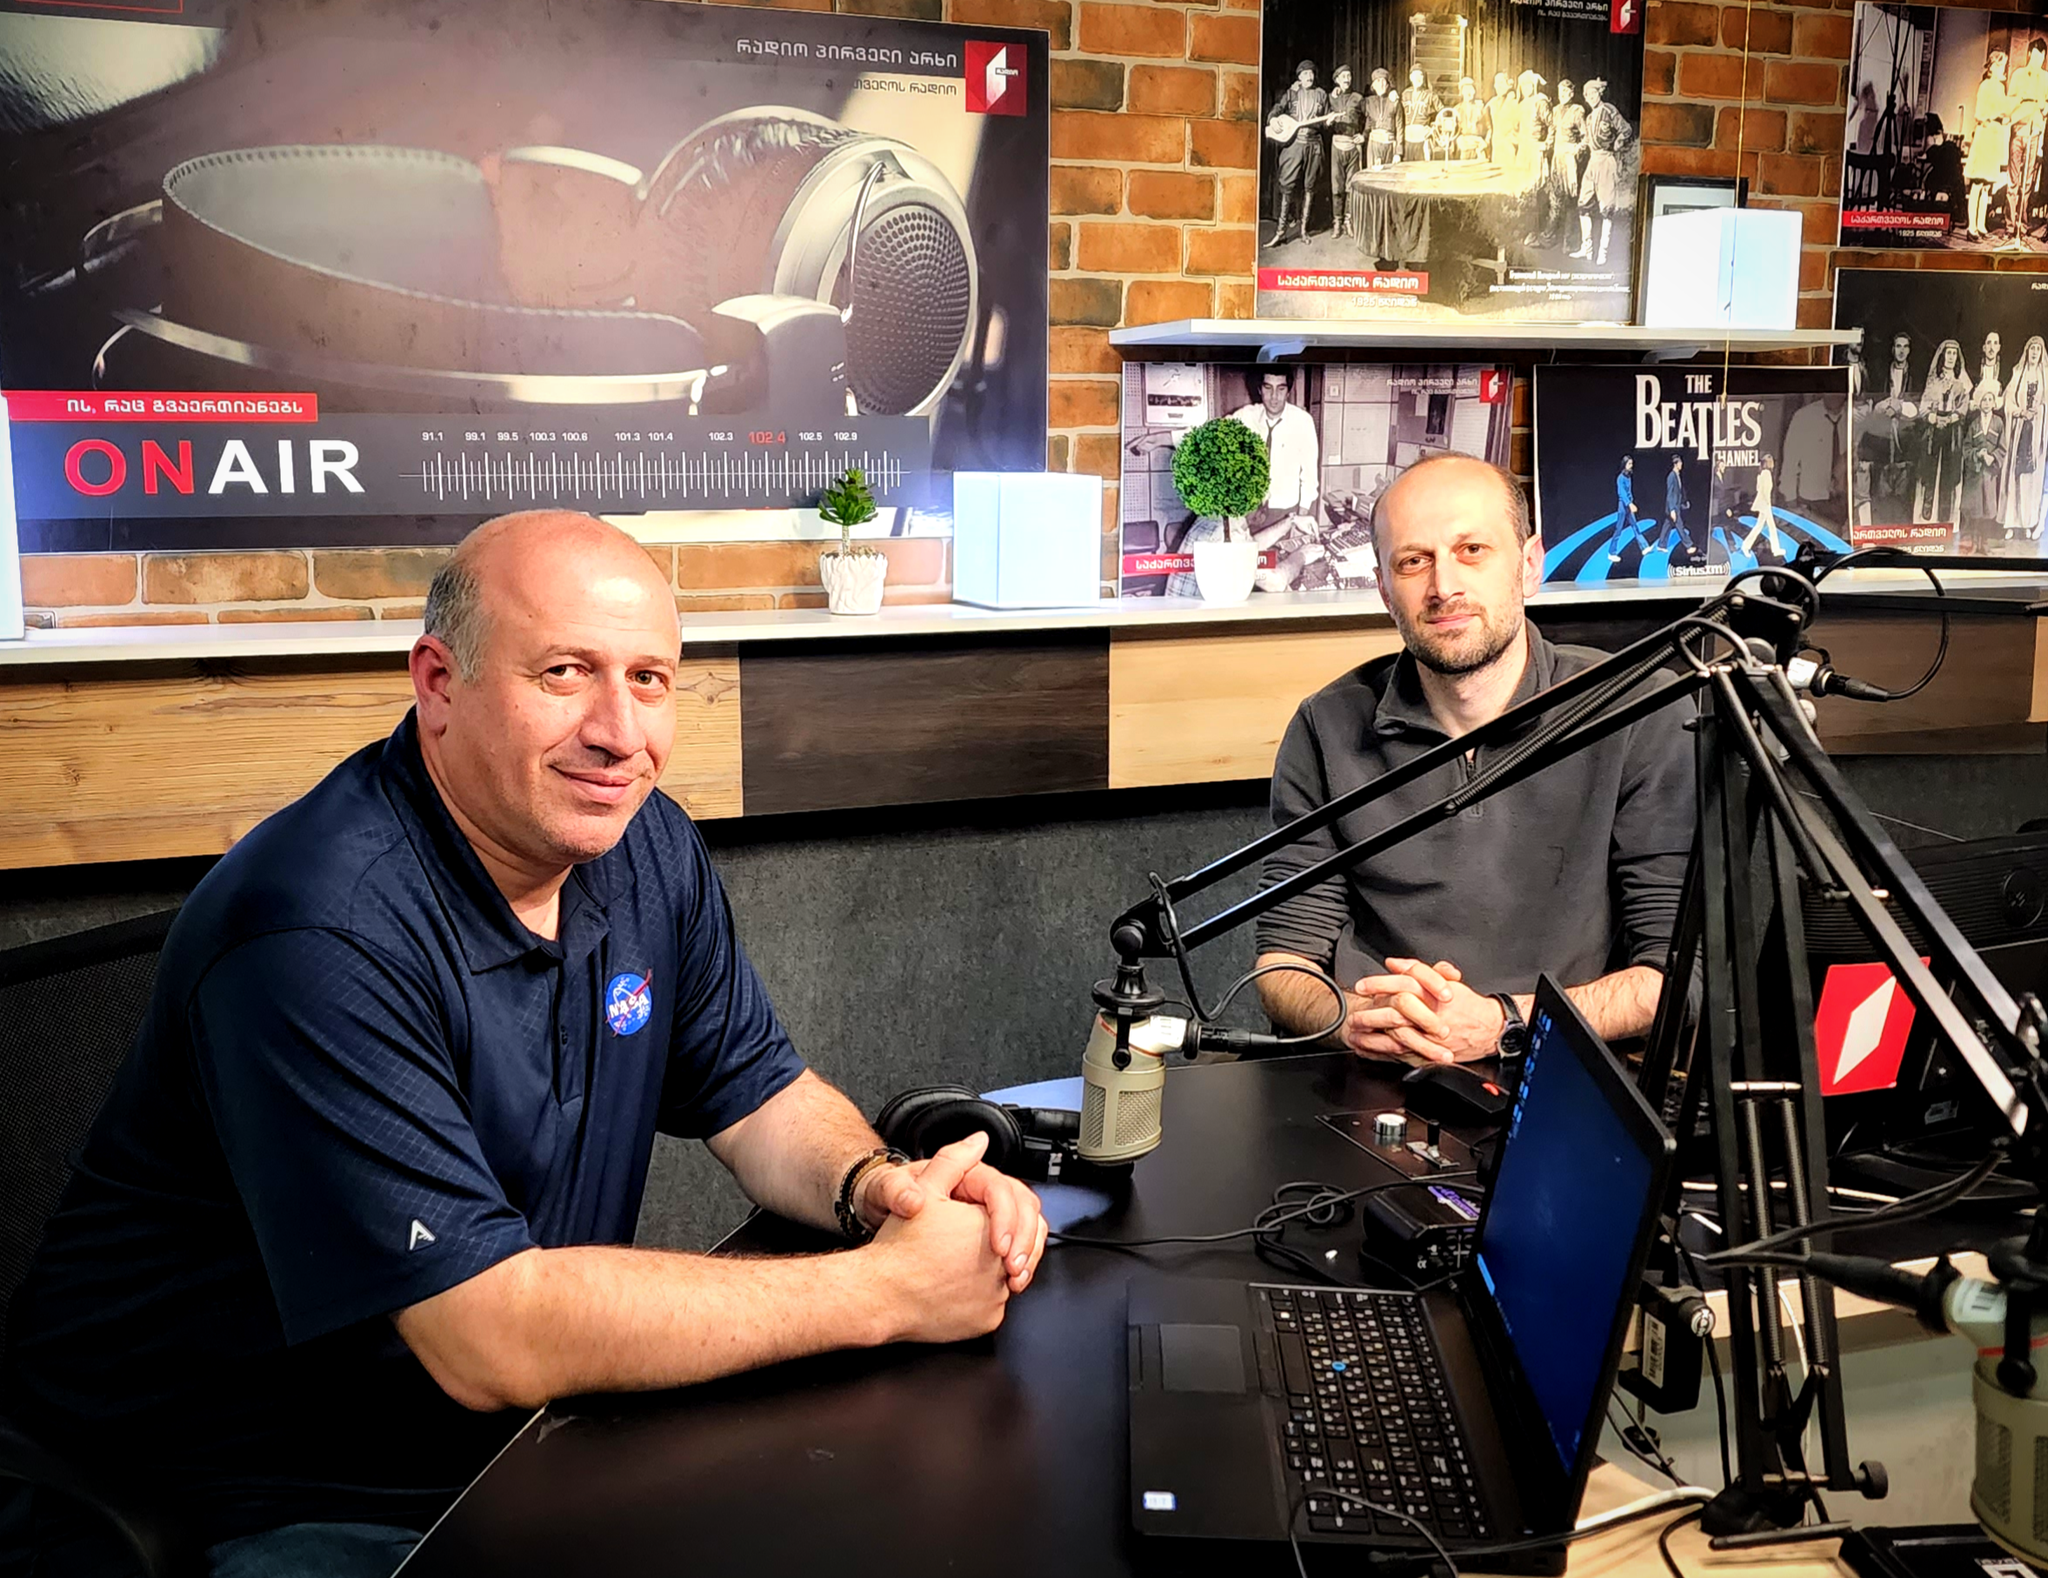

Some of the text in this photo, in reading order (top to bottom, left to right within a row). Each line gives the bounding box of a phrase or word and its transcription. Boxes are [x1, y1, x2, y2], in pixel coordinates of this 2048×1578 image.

[736, 38, 958, 69] რადიო პირველი არხი
[909, 82, 958, 96] რადიო
[1277, 275, 1420, 290] საქართველოს რადიო
[1684, 374, 1713, 394] THE
[104, 399, 146, 413] რაც
[152, 400, 303, 414] გვაერთიანებს
[1635, 374, 1762, 460] BEATLES
[421, 431, 444, 442] 91.1
[464, 431, 486, 442] 99.1
[496, 431, 519, 442] 99.5
[528, 431, 556, 442] 100.3
[561, 431, 588, 442] 100.6
[614, 431, 641, 442] 101.3
[647, 431, 674, 442] 101.4
[708, 431, 734, 442] 102.3
[798, 431, 823, 442] 102.5
[833, 431, 858, 442] 102.9
[64, 438, 366, 496] ON AIR
[1910, 527, 1947, 538] რადიო
[609, 993, 650, 1019] NASA
